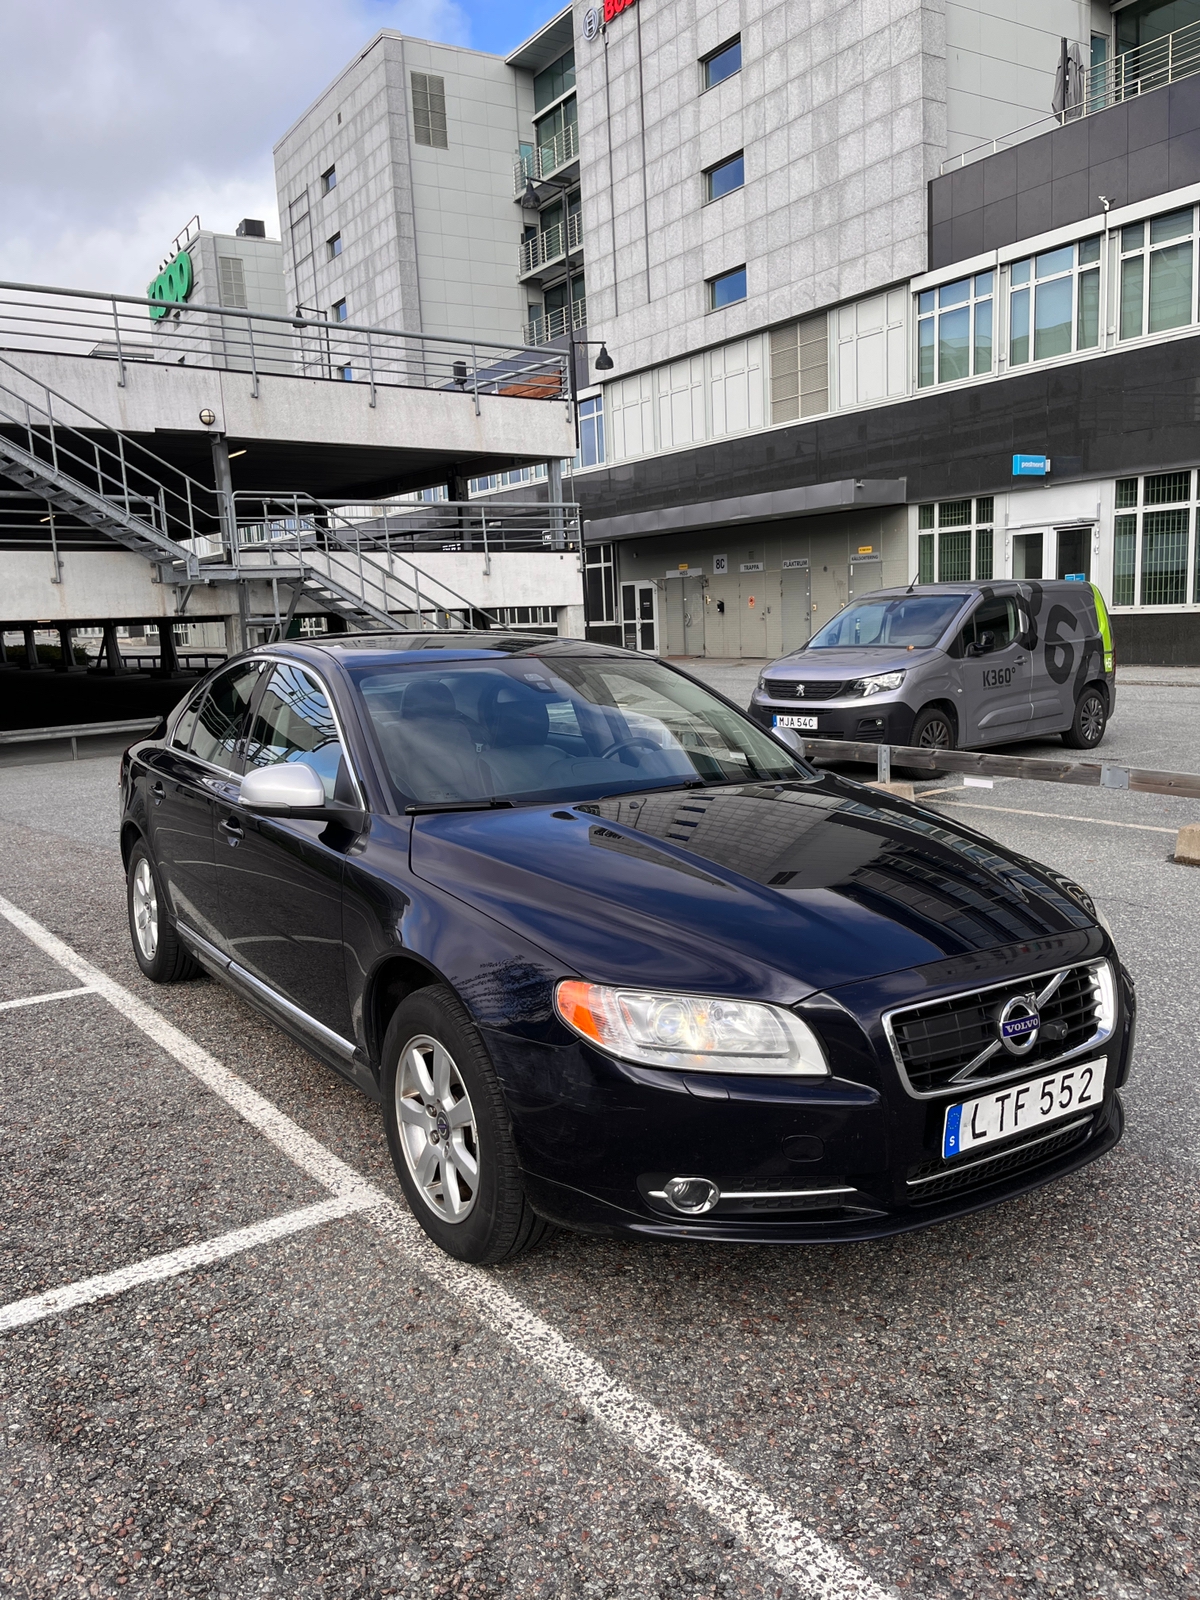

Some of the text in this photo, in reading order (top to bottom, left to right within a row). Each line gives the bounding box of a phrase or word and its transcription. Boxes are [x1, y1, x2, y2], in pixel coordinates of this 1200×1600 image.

[604, 0, 634, 22] BO
[715, 558, 725, 569] 8C
[783, 560, 808, 568] FLÄKTRUM
[779, 716, 814, 728] MJA 54C
[1005, 1018, 1039, 1033] VOLVO
[949, 1067, 1093, 1147] S LTF 552
